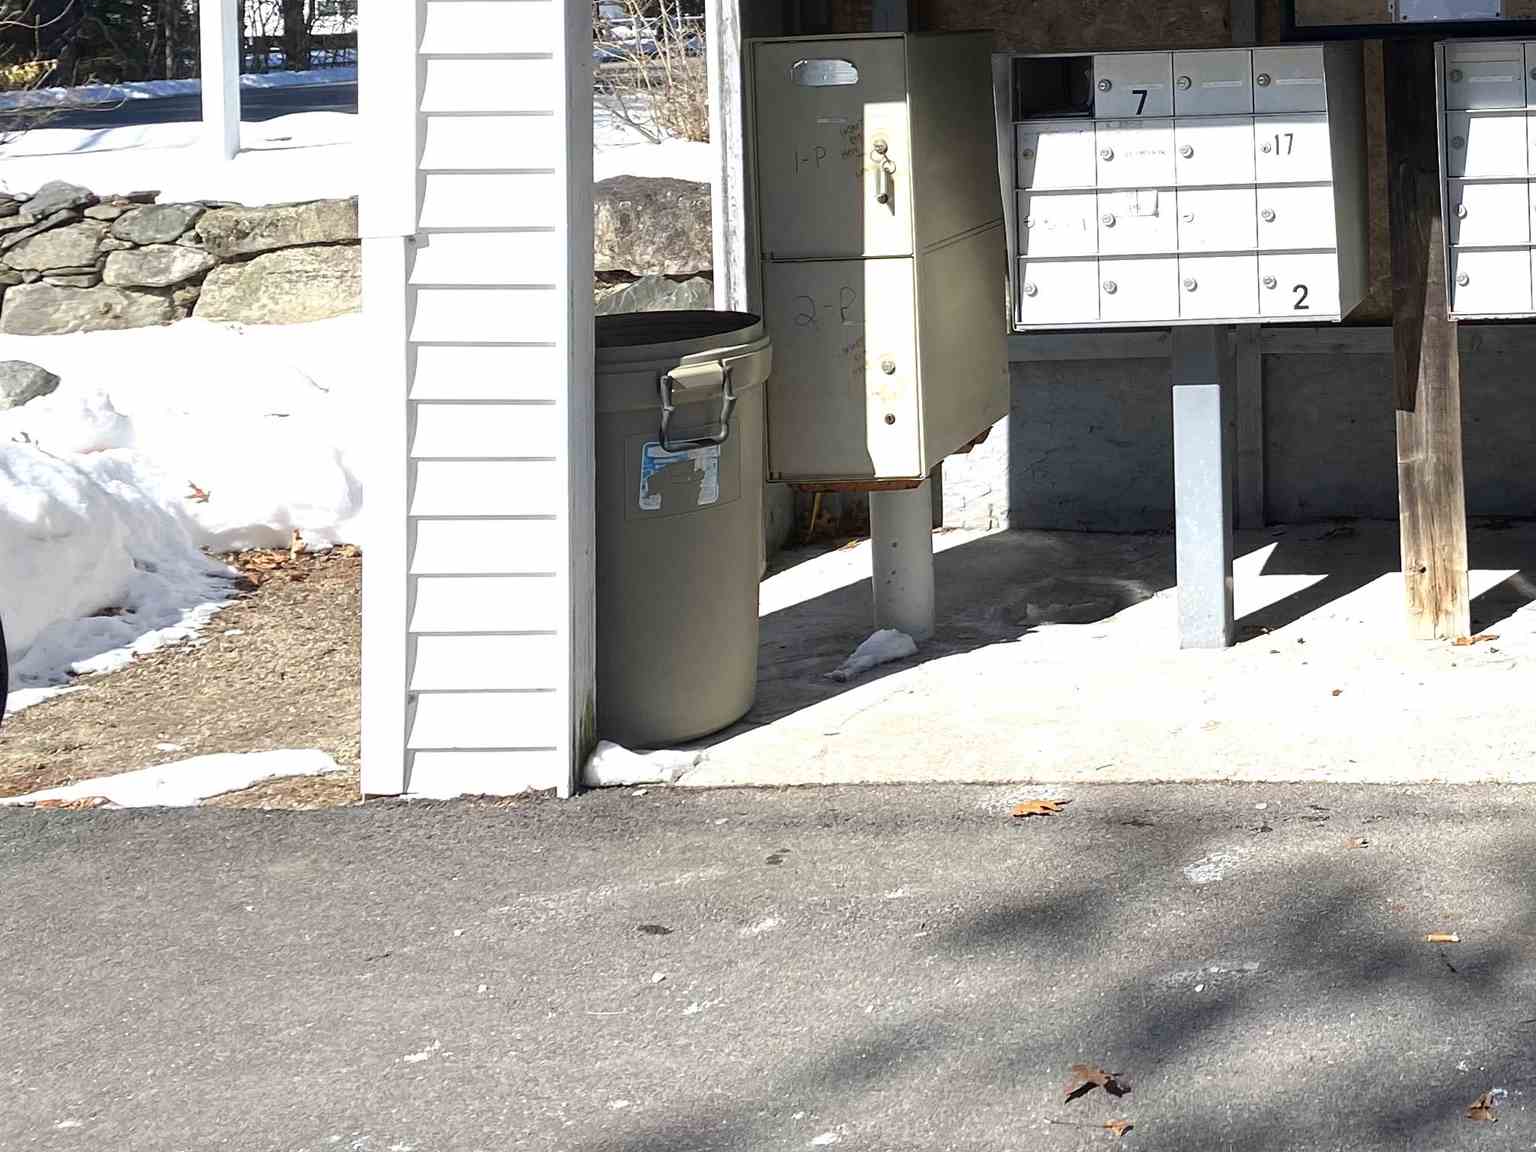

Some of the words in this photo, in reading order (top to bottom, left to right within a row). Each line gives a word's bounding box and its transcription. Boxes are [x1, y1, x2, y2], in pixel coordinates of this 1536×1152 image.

[1131, 89, 1148, 115] 7
[1274, 133, 1294, 156] 17
[1292, 284, 1310, 310] 2
